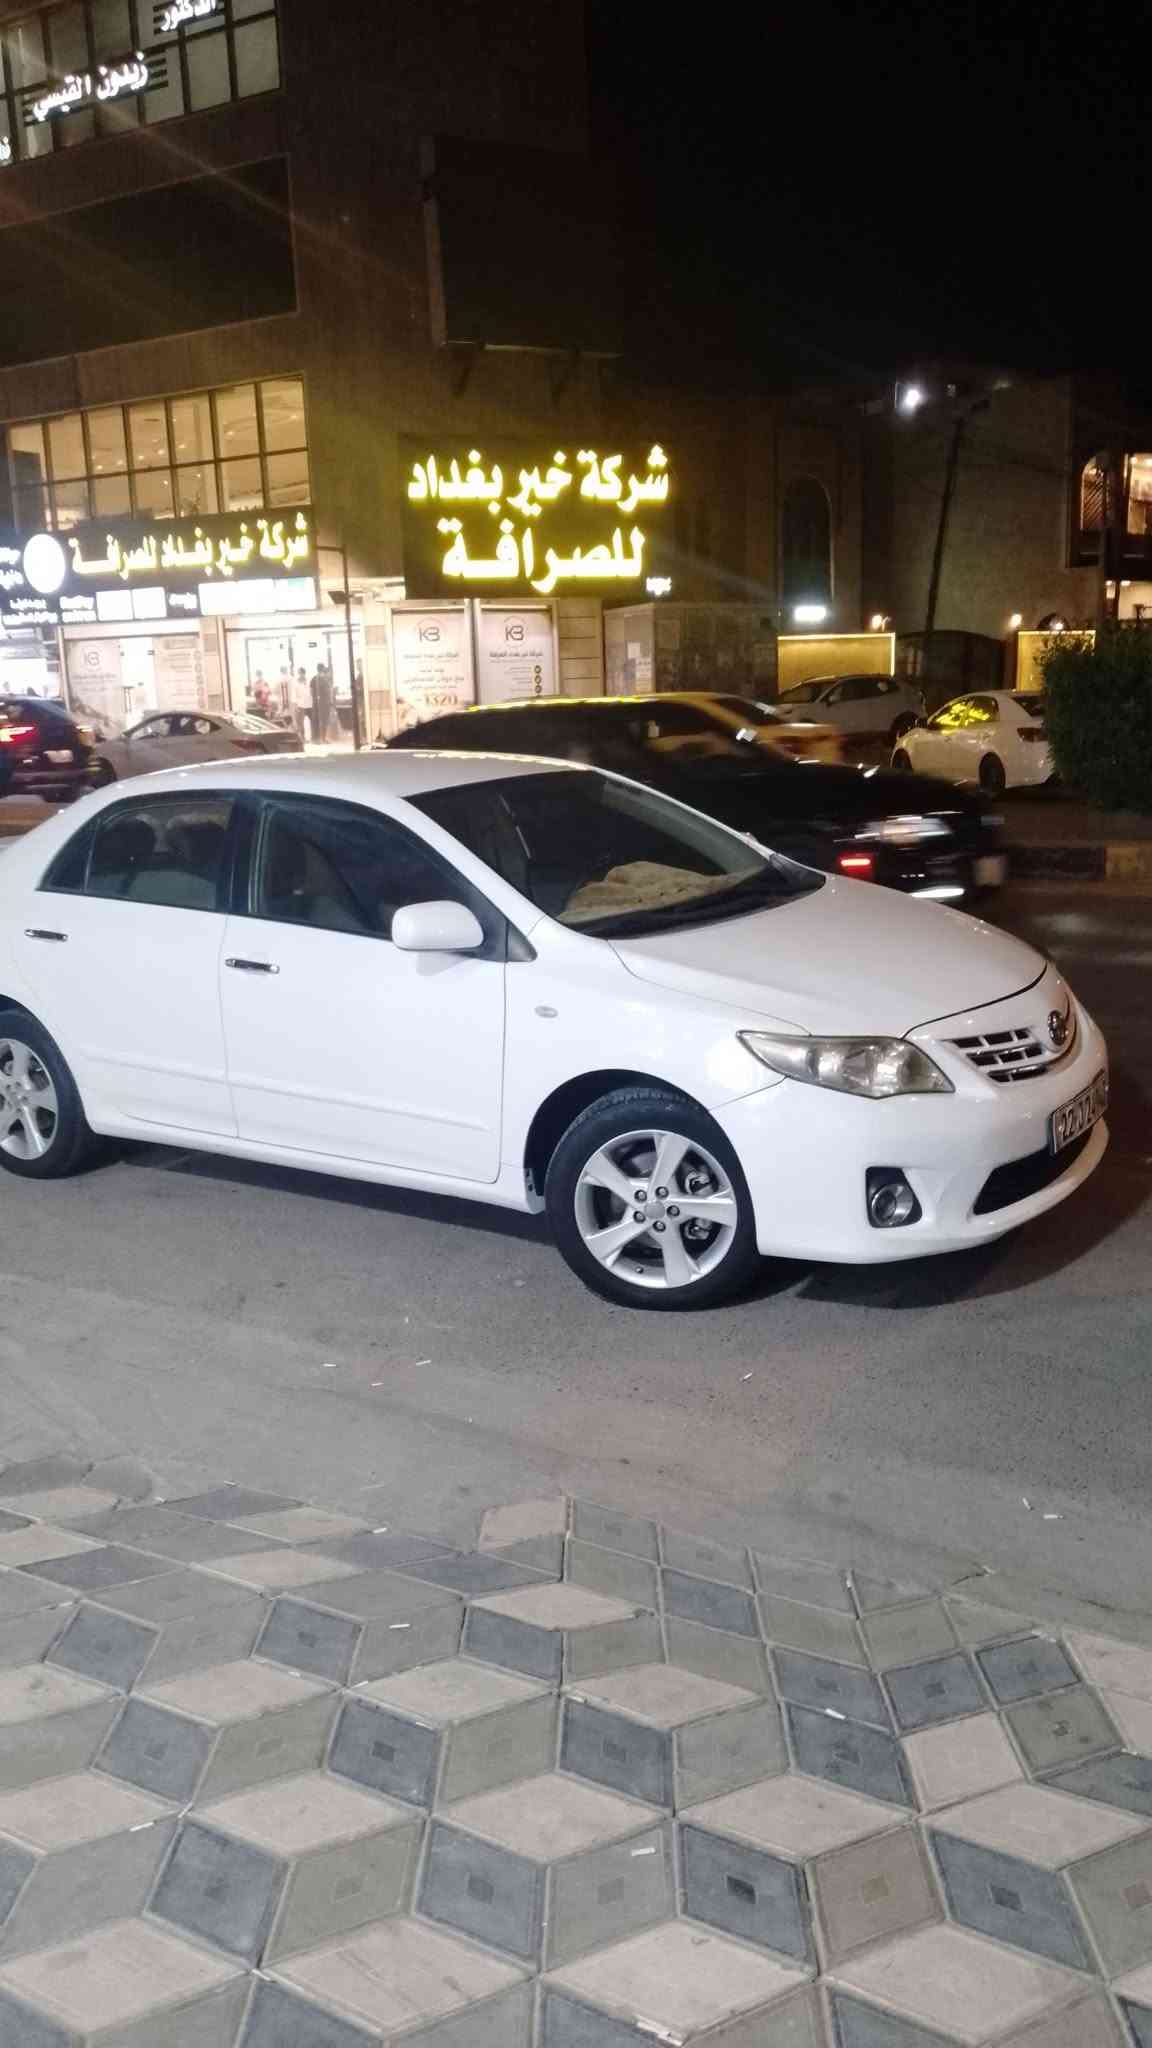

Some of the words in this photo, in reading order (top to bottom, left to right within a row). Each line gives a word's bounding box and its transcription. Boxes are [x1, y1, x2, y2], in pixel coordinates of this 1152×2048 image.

[407, 450, 503, 515] بغداد
[507, 450, 573, 517] خير
[577, 445, 669, 513] شركة
[68, 534, 159, 580] للصرافة
[161, 527, 214, 576] بغداد
[216, 523, 254, 577] خير
[257, 512, 309, 569] شركة
[437, 518, 646, 593] للصرافة
